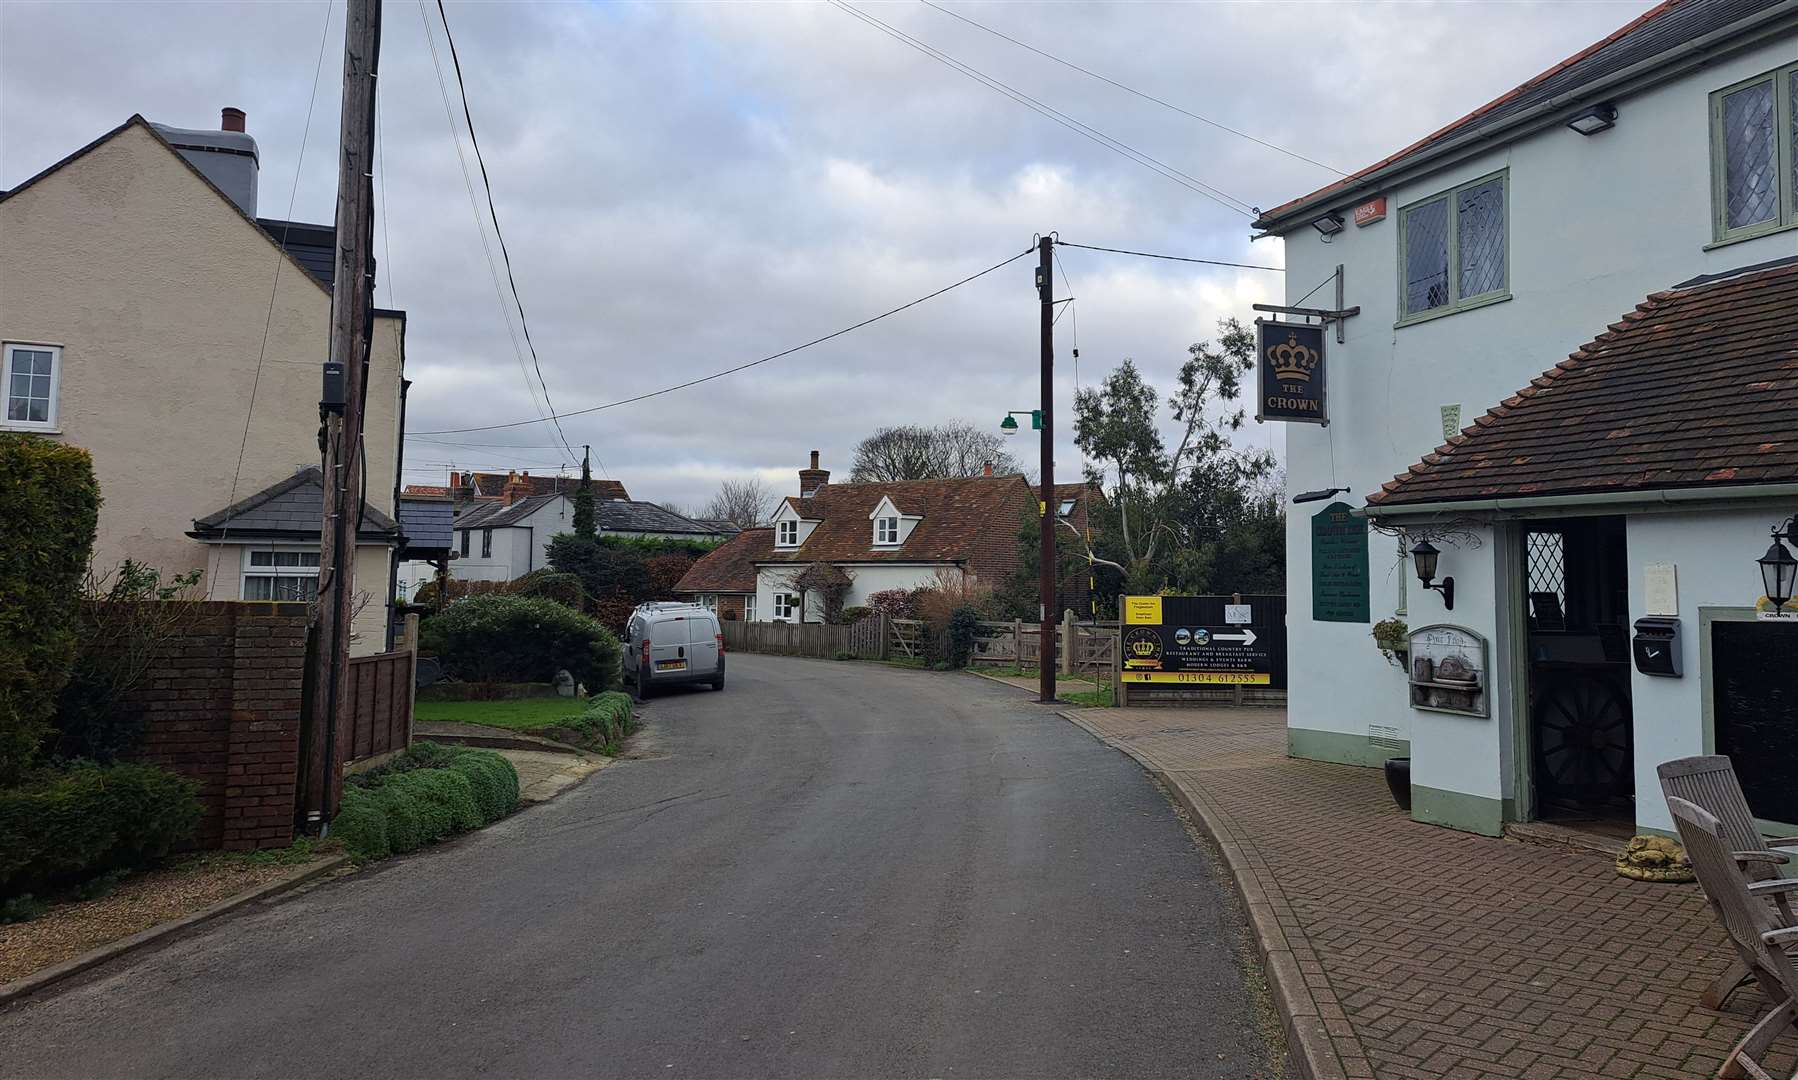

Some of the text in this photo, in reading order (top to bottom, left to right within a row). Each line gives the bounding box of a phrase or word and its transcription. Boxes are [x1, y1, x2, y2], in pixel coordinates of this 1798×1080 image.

[1282, 384, 1304, 394] THE
[1267, 396, 1318, 411] CROWN
[1178, 673, 1256, 683] 01304 612555
